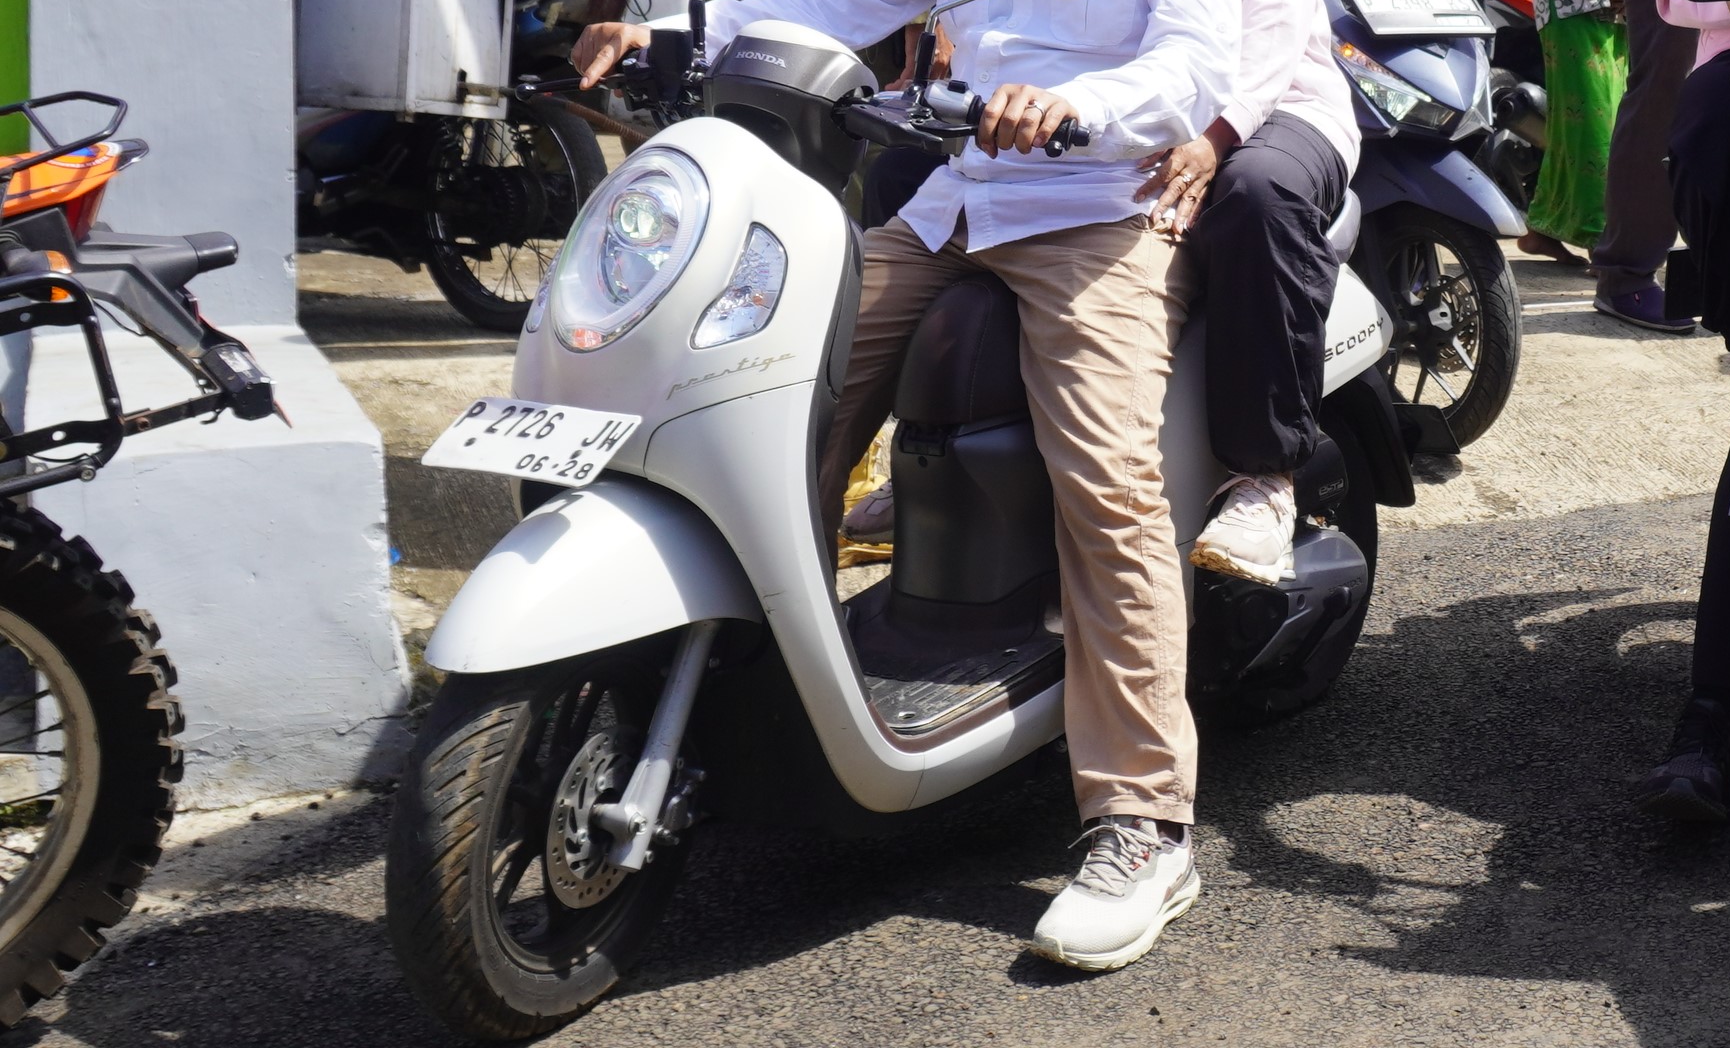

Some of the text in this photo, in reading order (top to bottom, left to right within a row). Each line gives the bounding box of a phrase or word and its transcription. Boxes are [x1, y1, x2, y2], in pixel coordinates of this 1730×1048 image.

[736, 51, 787, 69] HONDA
[1324, 316, 1384, 362] SCOOPY
[666, 353, 796, 401] prestige
[454, 400, 635, 452] P 2726 JW
